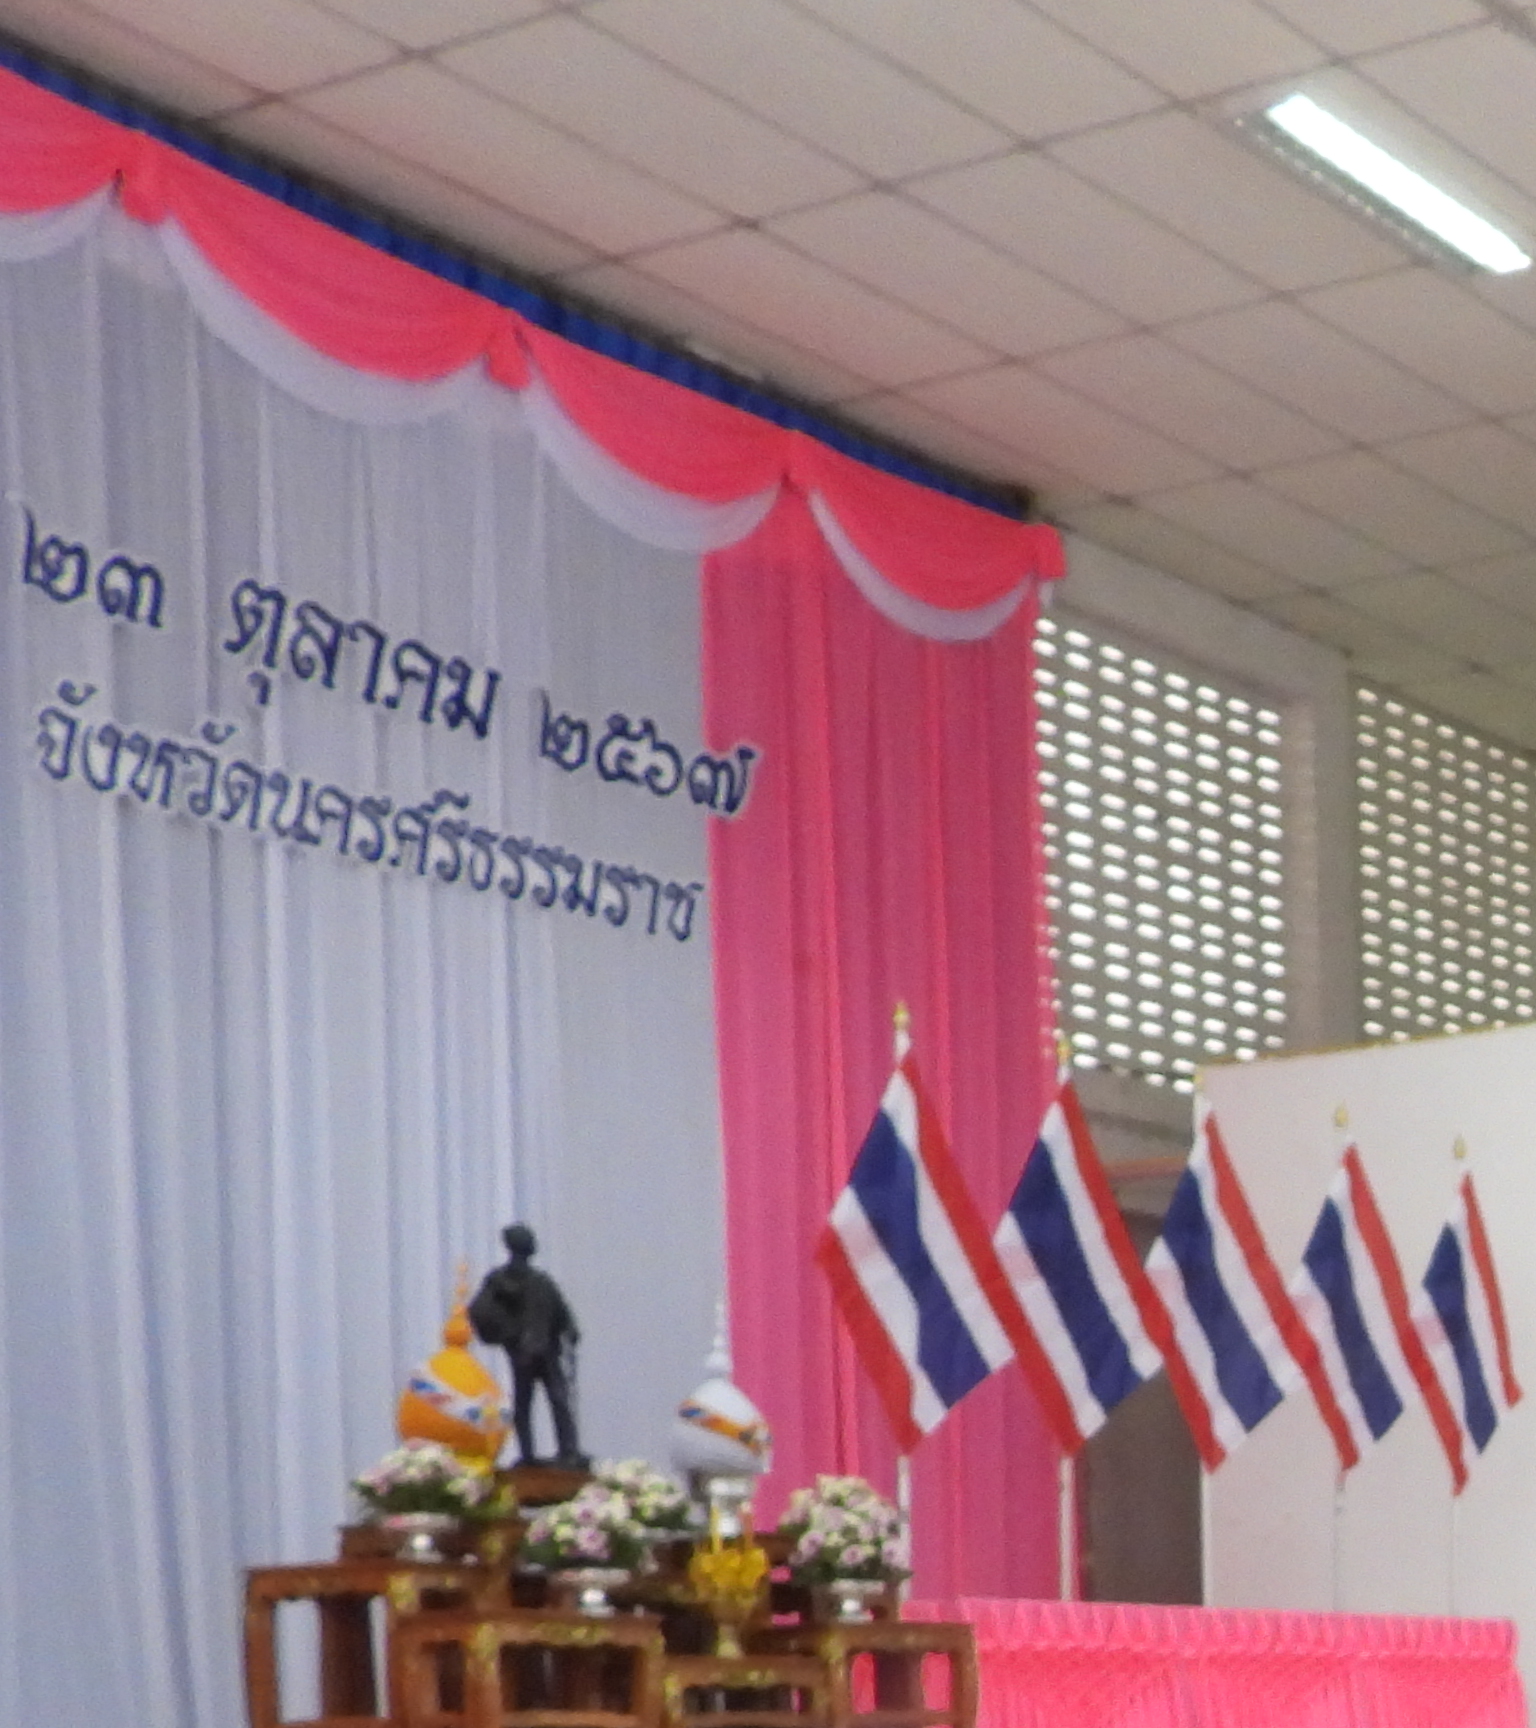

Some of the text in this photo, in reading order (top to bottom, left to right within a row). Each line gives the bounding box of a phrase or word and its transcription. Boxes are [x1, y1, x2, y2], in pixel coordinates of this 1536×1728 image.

[22, 509, 757, 815] ๒๓ ตุลาคม ๒๕๖๗
[37, 682, 703, 942] จังหวัดนครศรีธรรมราช
